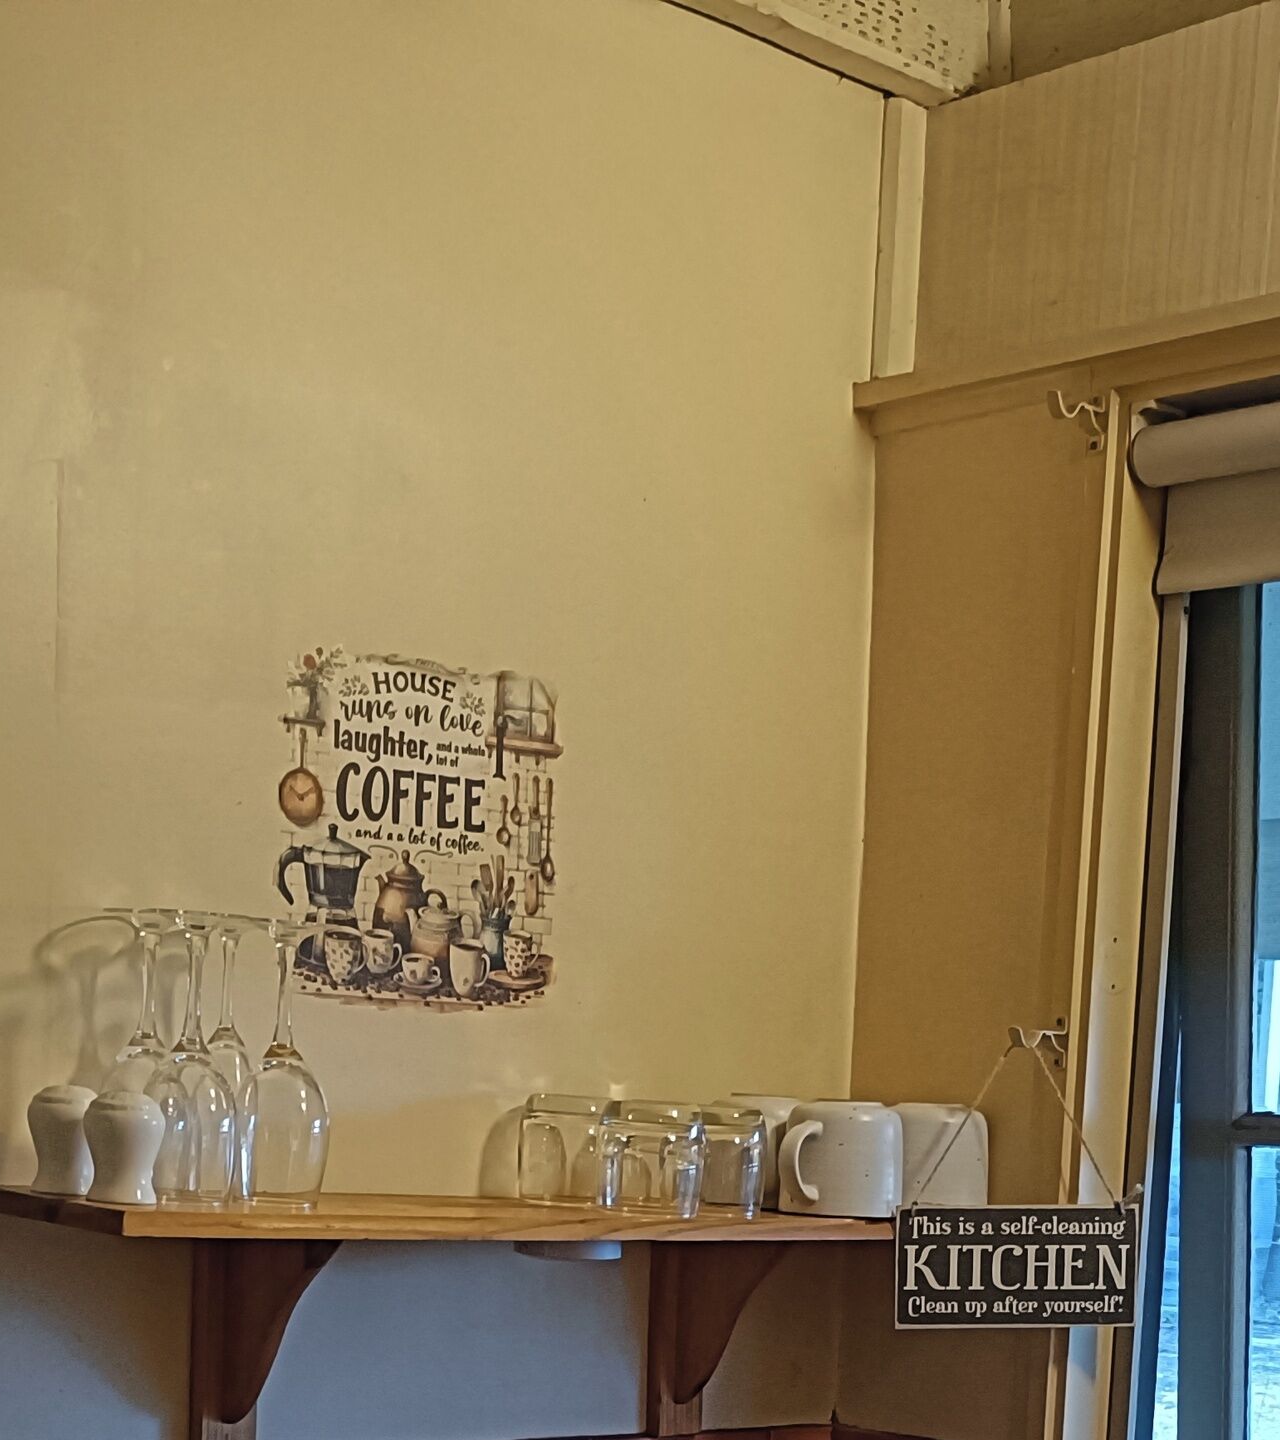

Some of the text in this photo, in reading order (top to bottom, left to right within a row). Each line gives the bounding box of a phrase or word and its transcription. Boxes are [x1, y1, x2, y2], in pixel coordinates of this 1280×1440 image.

[371, 671, 457, 703] HOUSE
[339, 698, 484, 737] runs on love
[333, 719, 433, 765] laughter,
[436, 741, 486, 756] and a whole
[436, 754, 459, 767] lot of
[335, 762, 486, 833] COFFEE
[355, 824, 485, 855] and a a lot of coffee.
[909, 1216, 1127, 1239] This is a self-cleaning
[903, 1244, 1131, 1291] KITCHEN
[908, 1295, 1124, 1317] Clean up after yourself!
